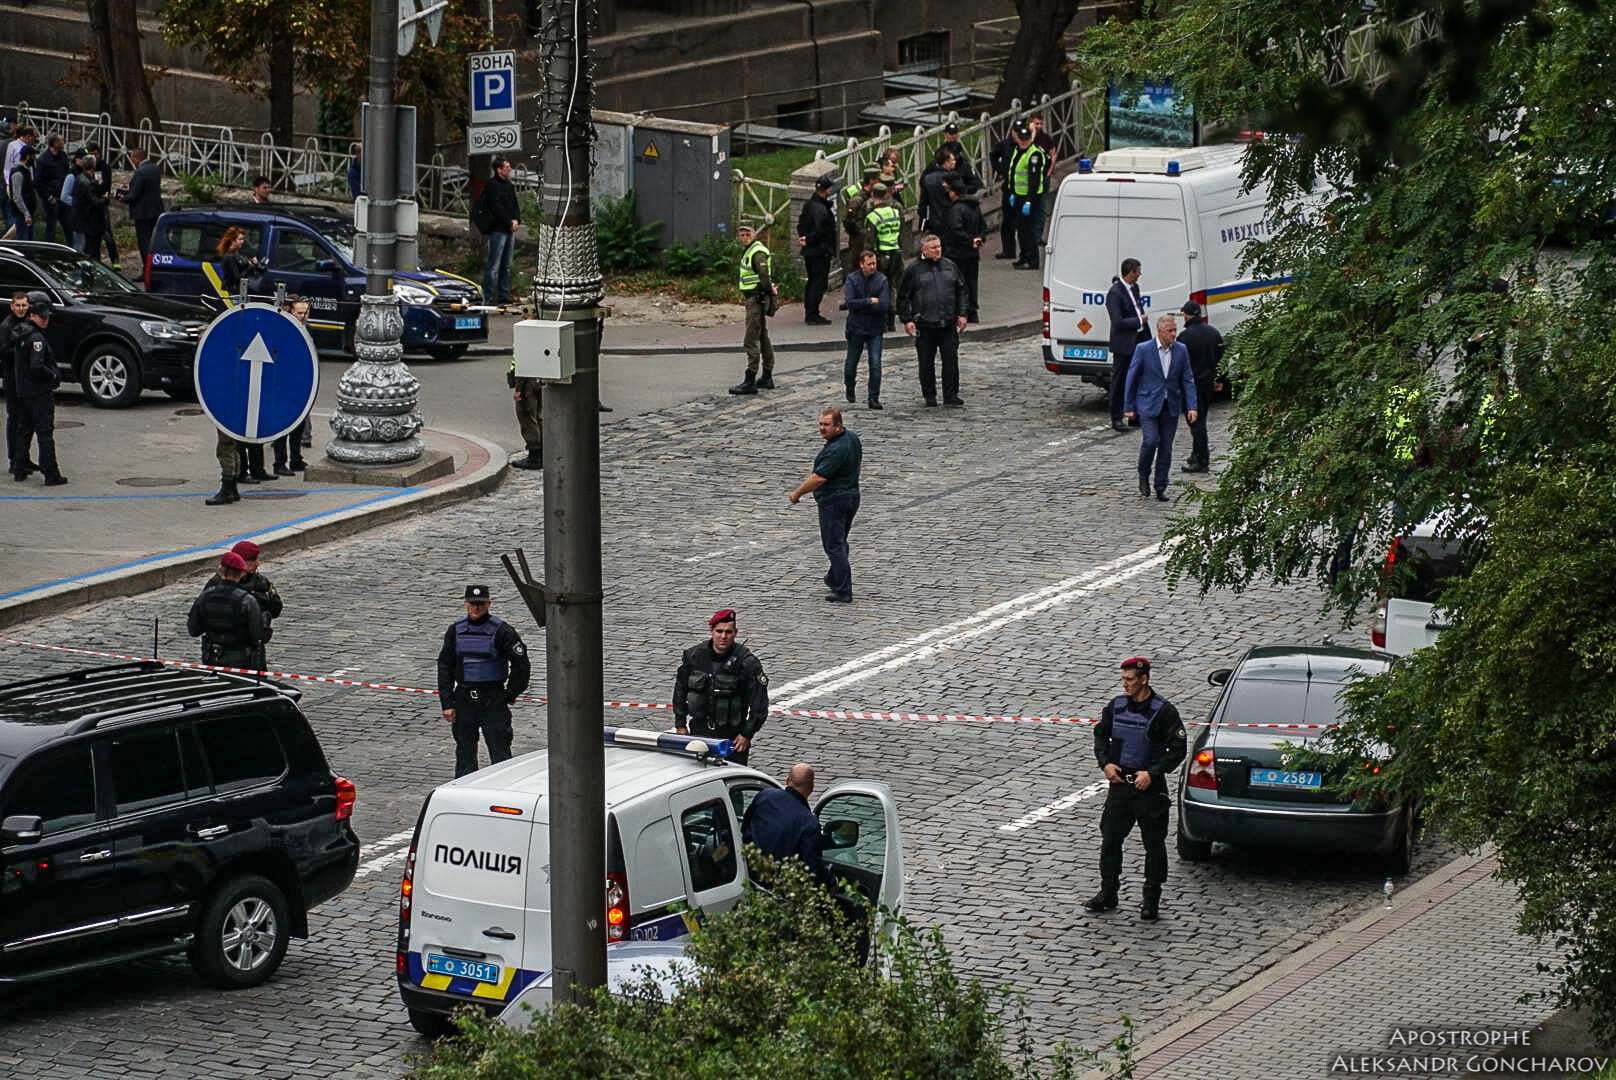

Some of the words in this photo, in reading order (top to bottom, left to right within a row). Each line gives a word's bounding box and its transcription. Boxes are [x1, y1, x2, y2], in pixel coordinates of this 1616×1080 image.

[472, 55, 513, 70] ЗОНА
[484, 74, 505, 107] P
[500, 132, 513, 144] 50
[161, 255, 173, 265] 102
[1282, 772, 1314, 785] 2587
[434, 844, 522, 875] ПОЛІЦІЯ
[644, 926, 659, 941] 102
[460, 962, 490, 979] 3051
